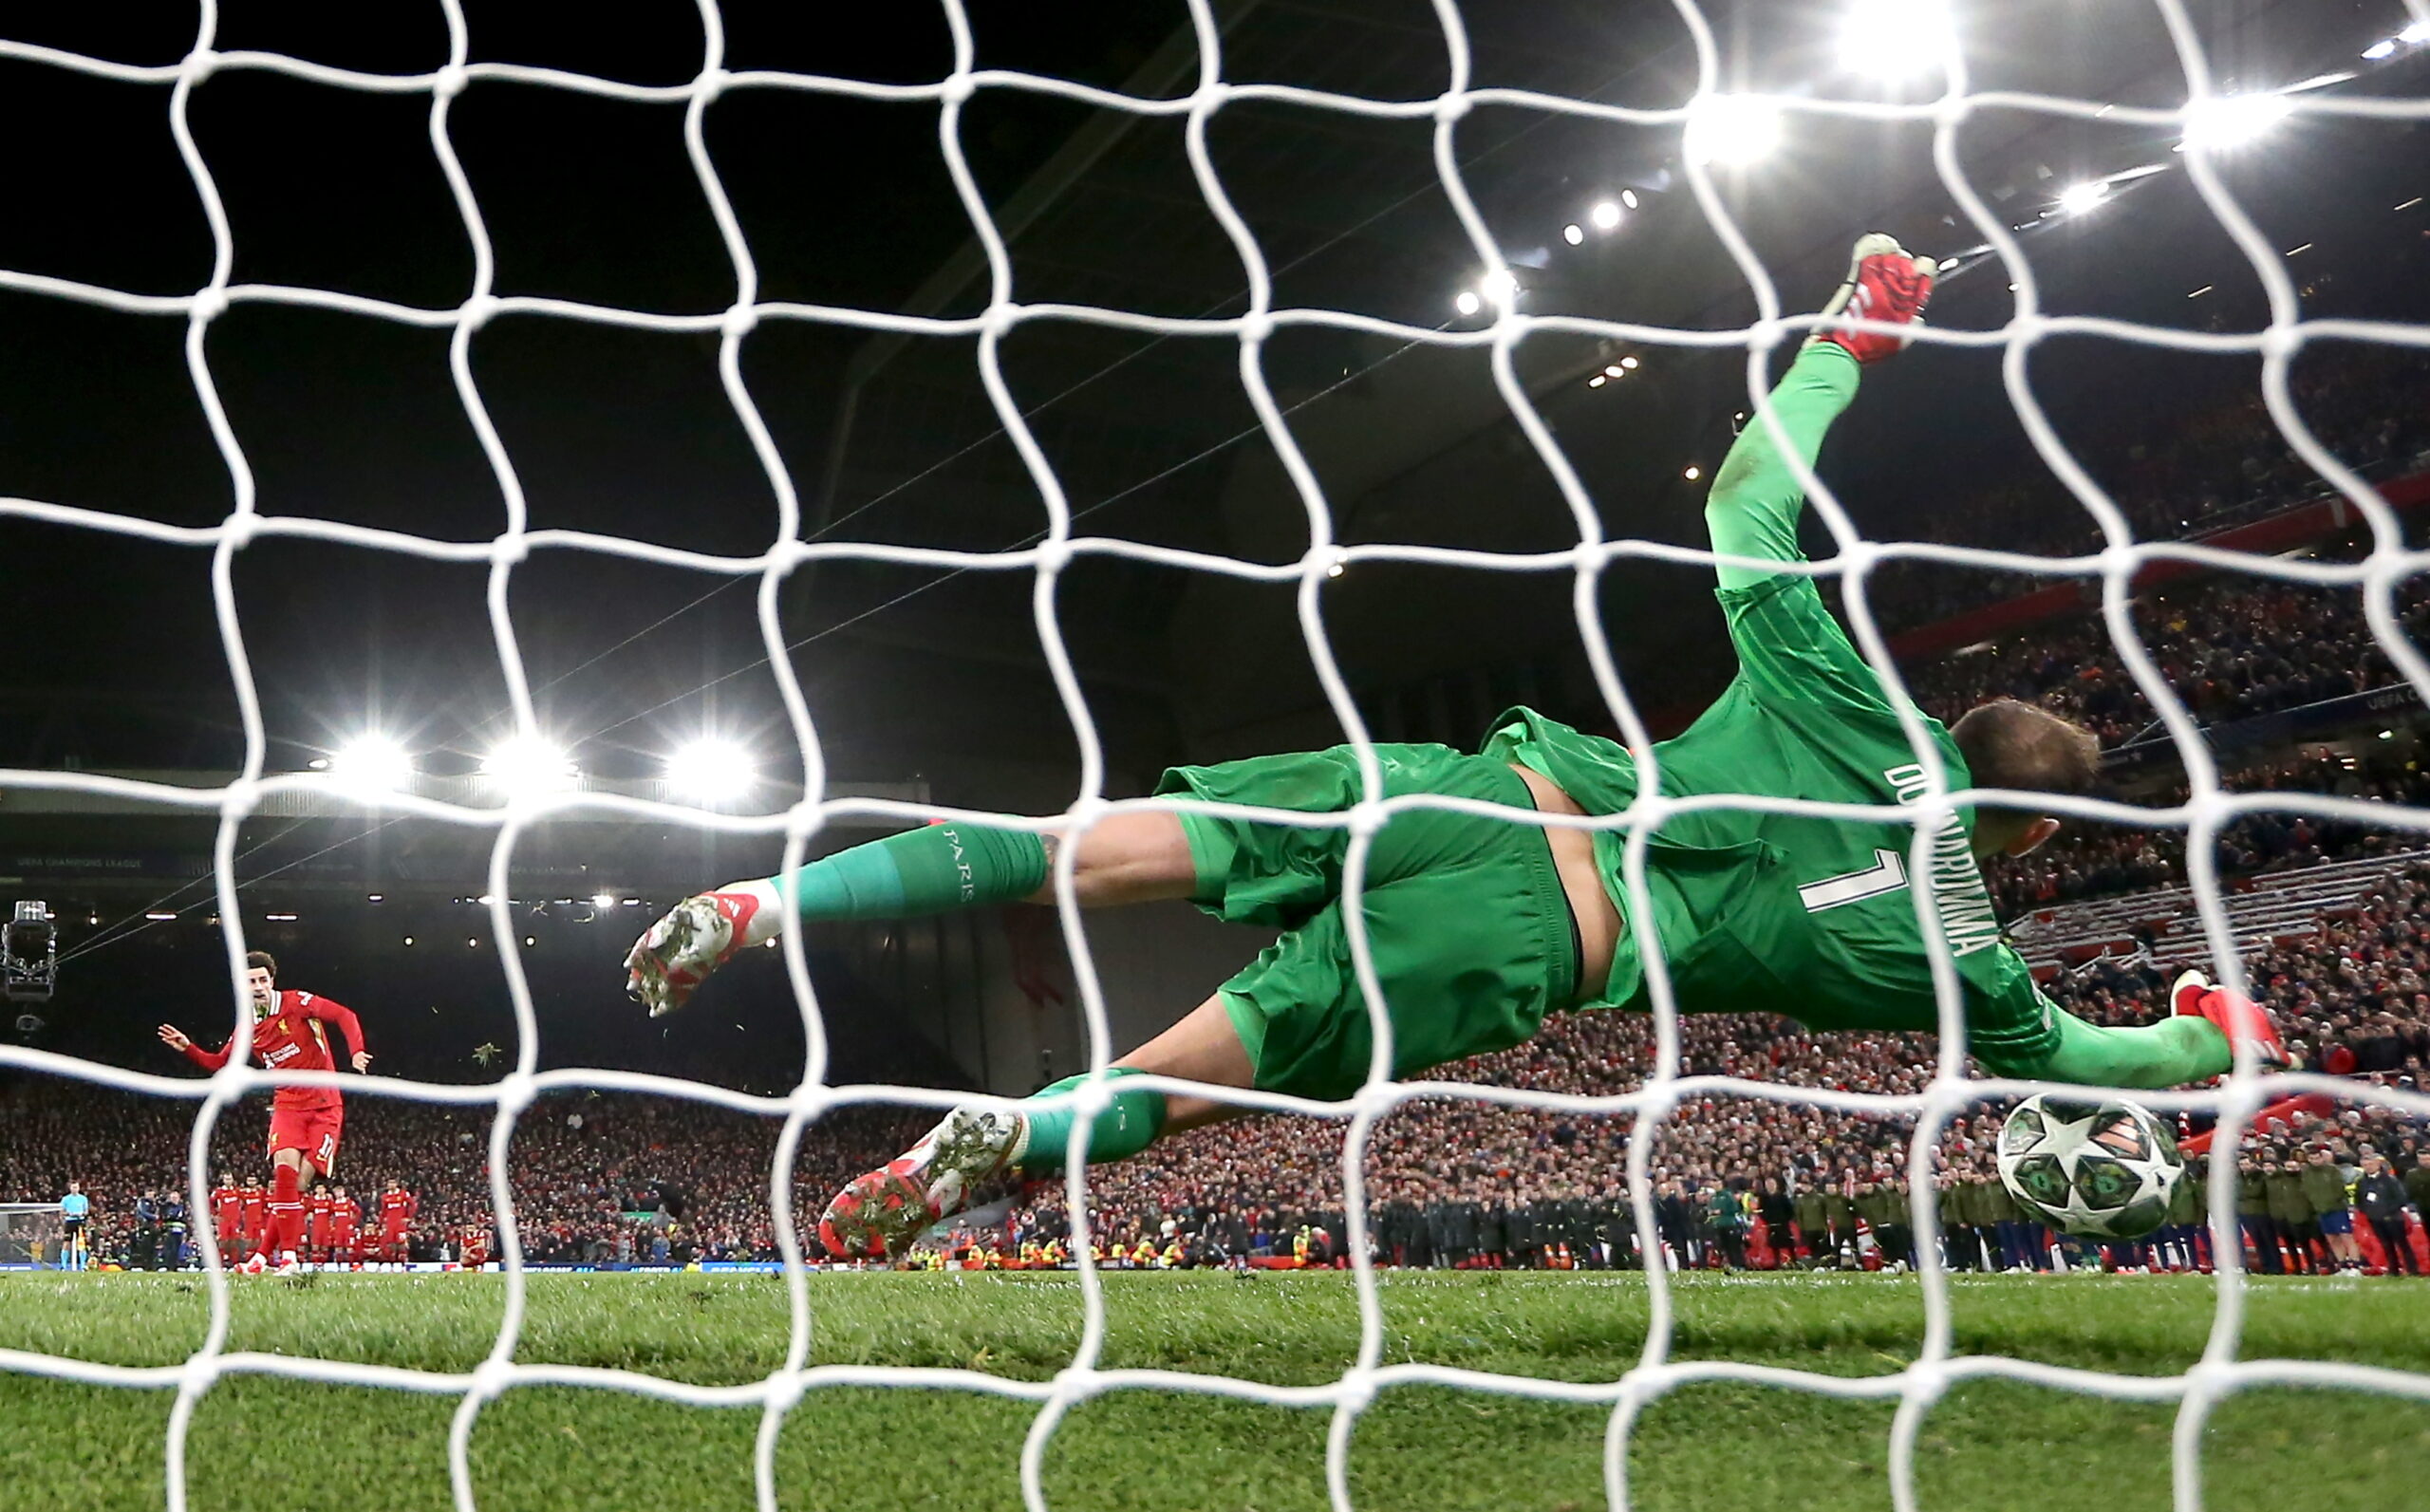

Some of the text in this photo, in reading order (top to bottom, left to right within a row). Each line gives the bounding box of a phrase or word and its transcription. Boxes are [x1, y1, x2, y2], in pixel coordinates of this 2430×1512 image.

[17, 858, 43, 867] UEFA
[45, 858, 103, 868] CHAMPIONS
[943, 830, 974, 903] PARIS
[1798, 849, 1909, 913] 1
[1884, 763, 1999, 958] DONARUMMA
